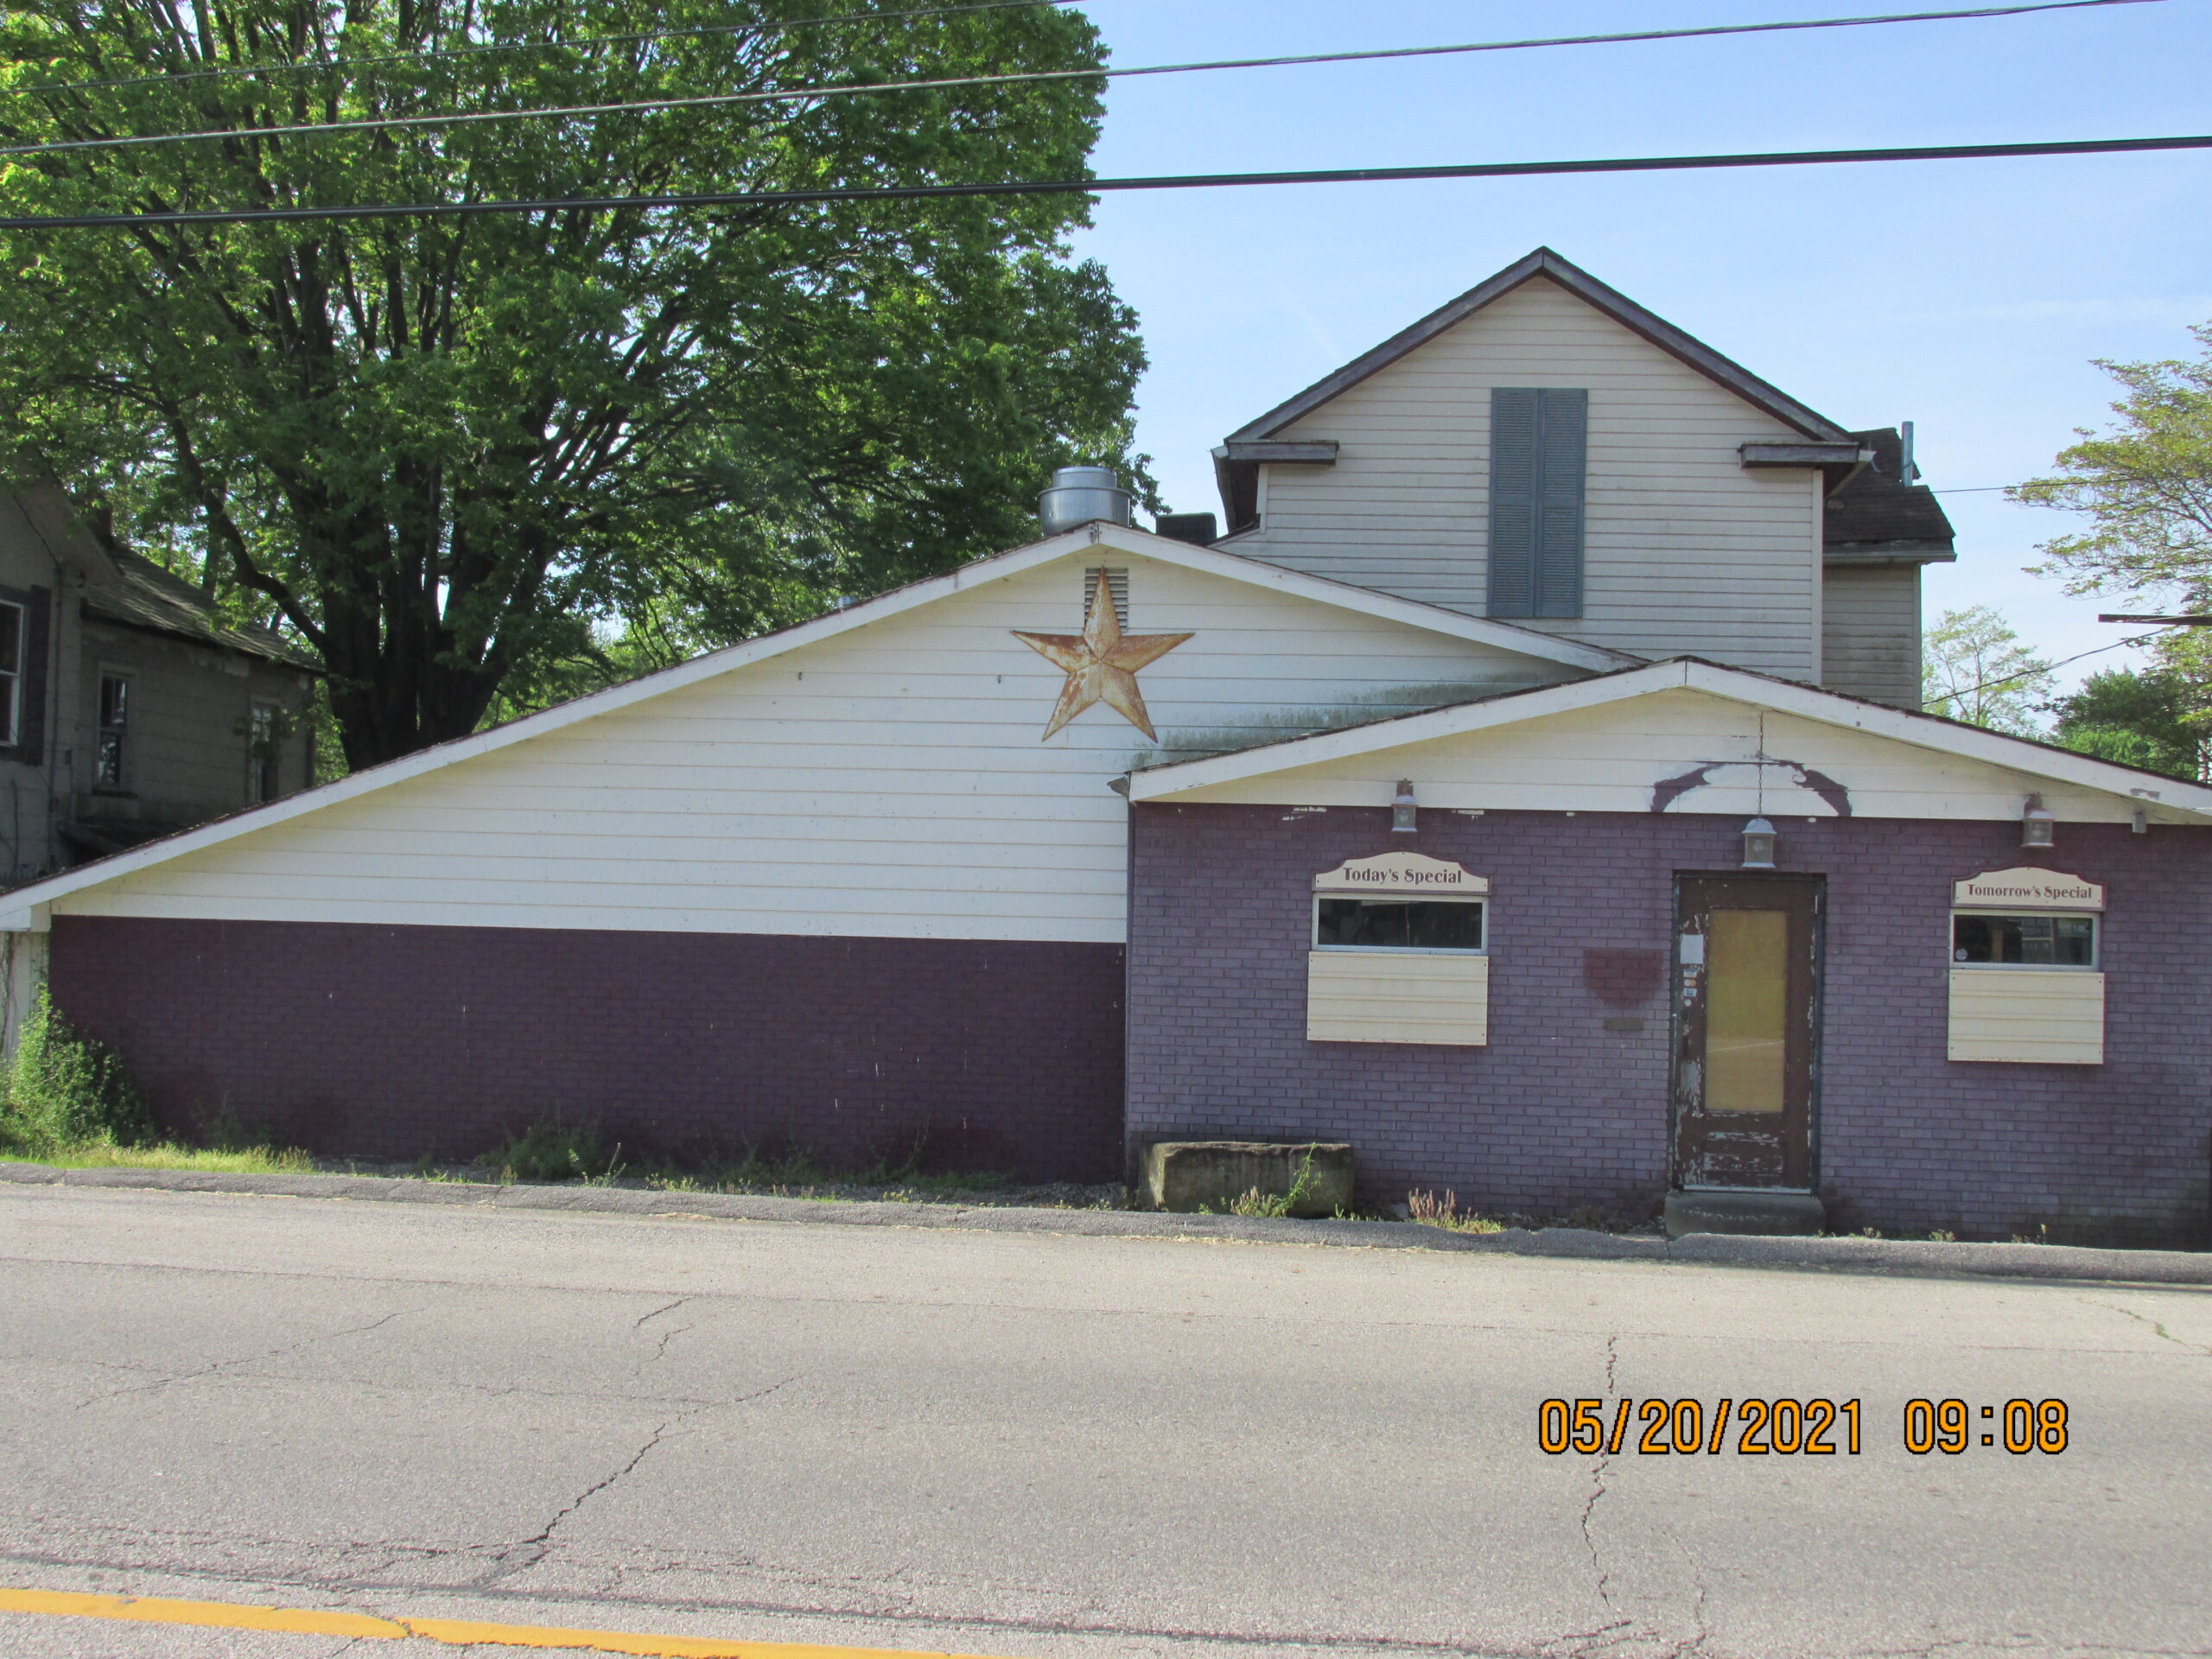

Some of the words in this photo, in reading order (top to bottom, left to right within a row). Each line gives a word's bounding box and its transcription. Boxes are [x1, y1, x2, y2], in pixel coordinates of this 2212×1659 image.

[1343, 867, 1399, 885] Today's
[1404, 868, 1462, 885] Special
[1967, 884, 2041, 898] Tomorrow's
[2044, 886, 2092, 899] Special
